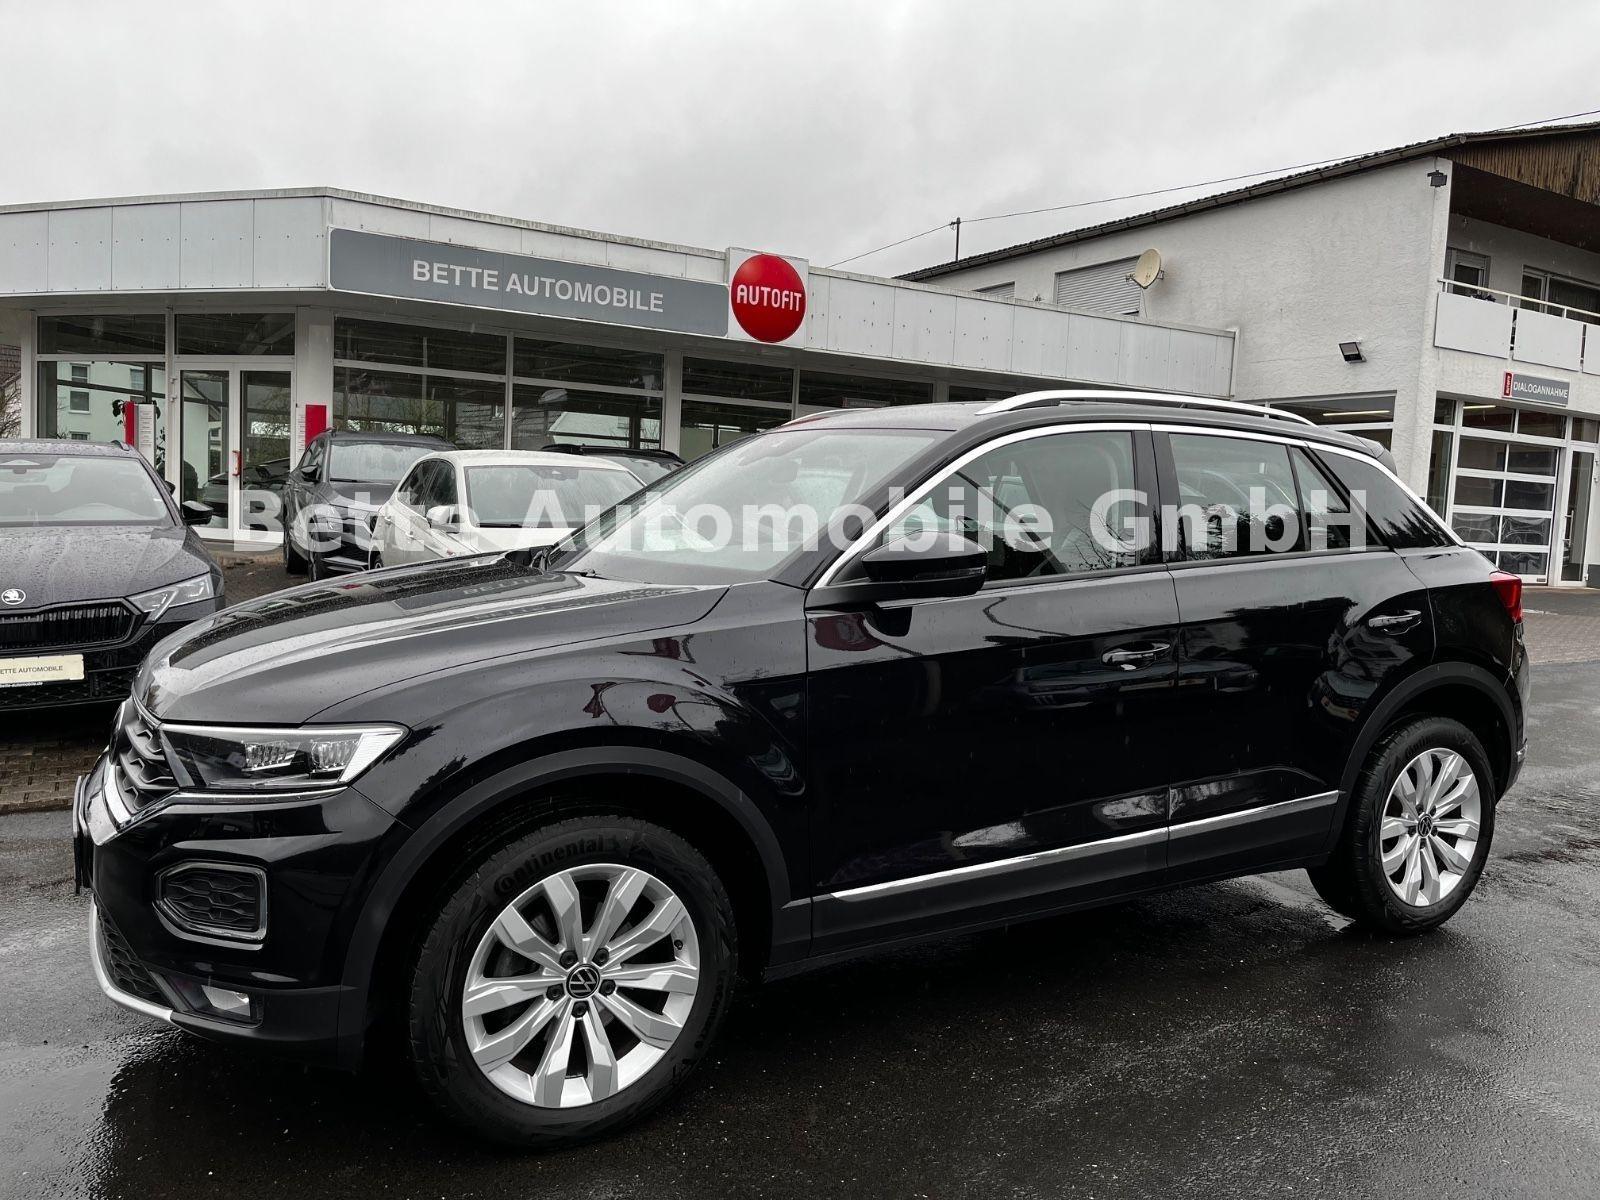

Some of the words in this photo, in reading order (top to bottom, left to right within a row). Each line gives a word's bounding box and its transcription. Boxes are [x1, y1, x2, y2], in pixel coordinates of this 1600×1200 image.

[412, 259, 499, 291] BETTE
[506, 272, 664, 313] AUTOMOBILE
[736, 284, 802, 312] AUTOFIT
[1513, 381, 1568, 398] DIALOGANNAHME
[18, 665, 63, 673] AUTOMOBILE
